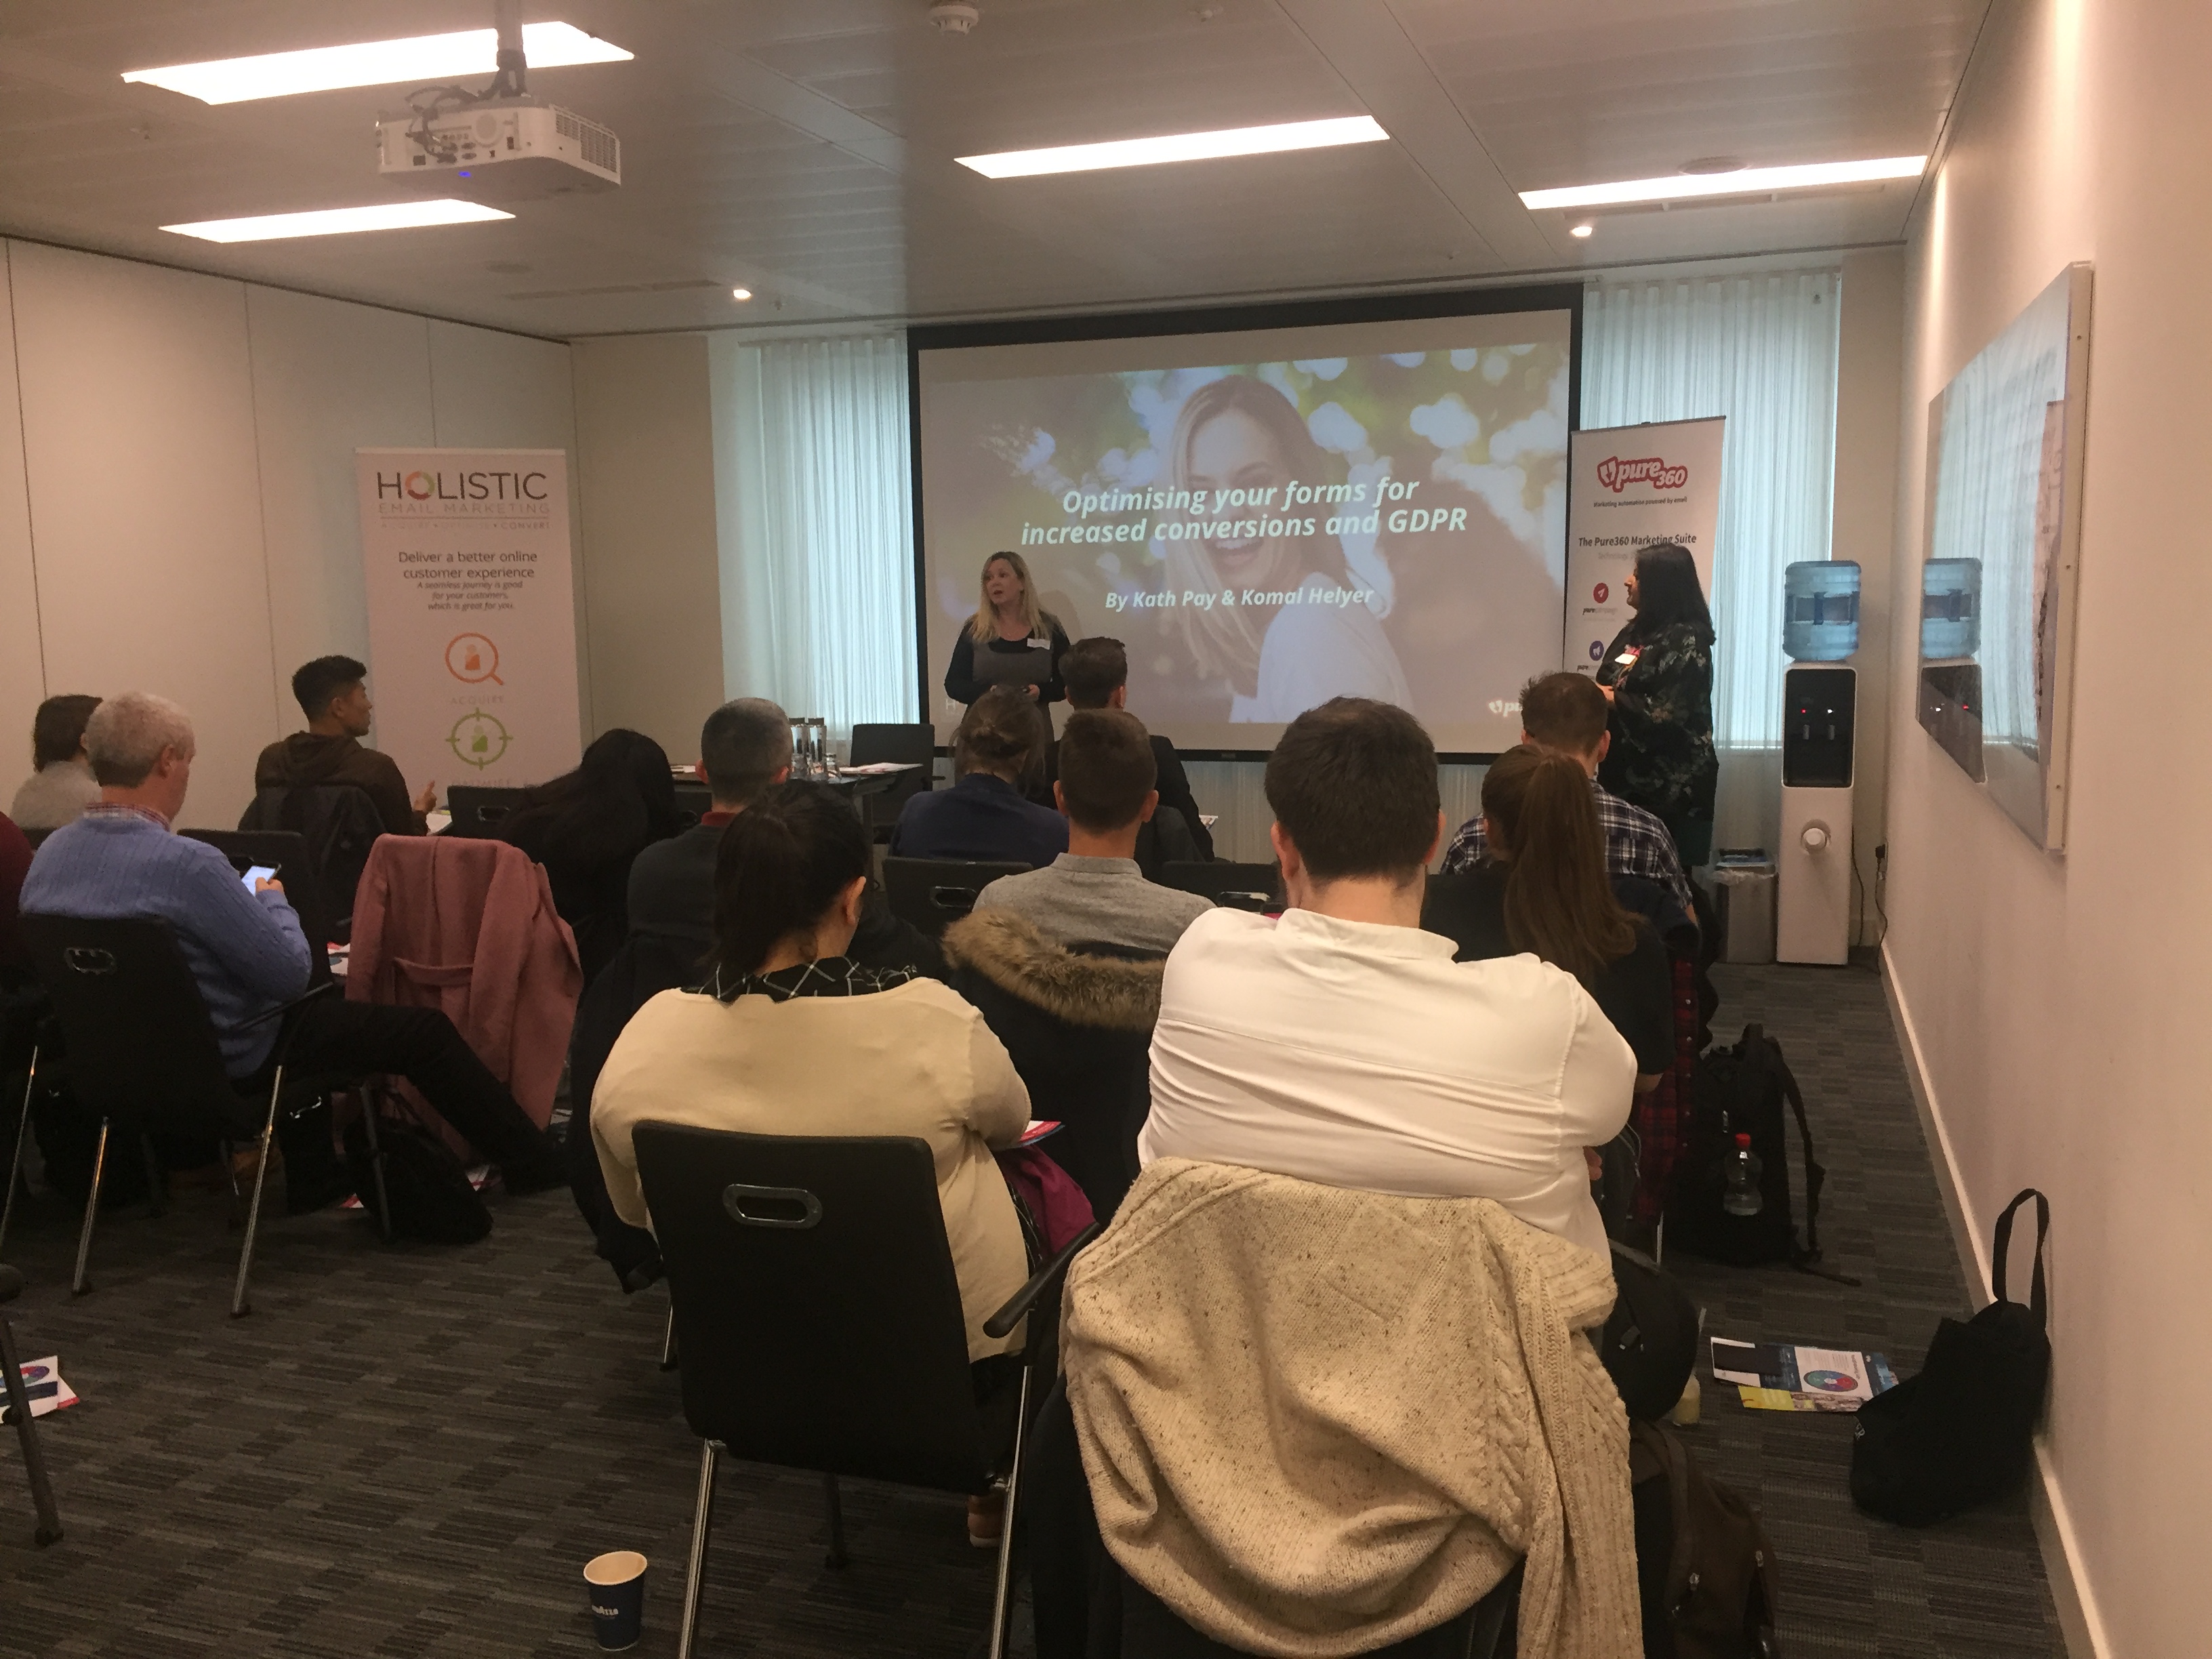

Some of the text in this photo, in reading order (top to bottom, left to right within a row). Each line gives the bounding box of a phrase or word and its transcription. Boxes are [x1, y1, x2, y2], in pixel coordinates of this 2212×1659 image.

[377, 470, 548, 501] HOLISTIC
[378, 501, 550, 514] EMAIL MARKETING
[1063, 476, 1420, 520] Optimising your forms for
[1021, 507, 1468, 546] increased conversions and GDPR
[1578, 532, 1697, 547] The Pure360 Marketing Suite
[398, 550, 537, 563] Deliver a better online
[403, 567, 535, 580] customer experience
[1105, 586, 1374, 613] By Kath Pay & Komal Helyer
